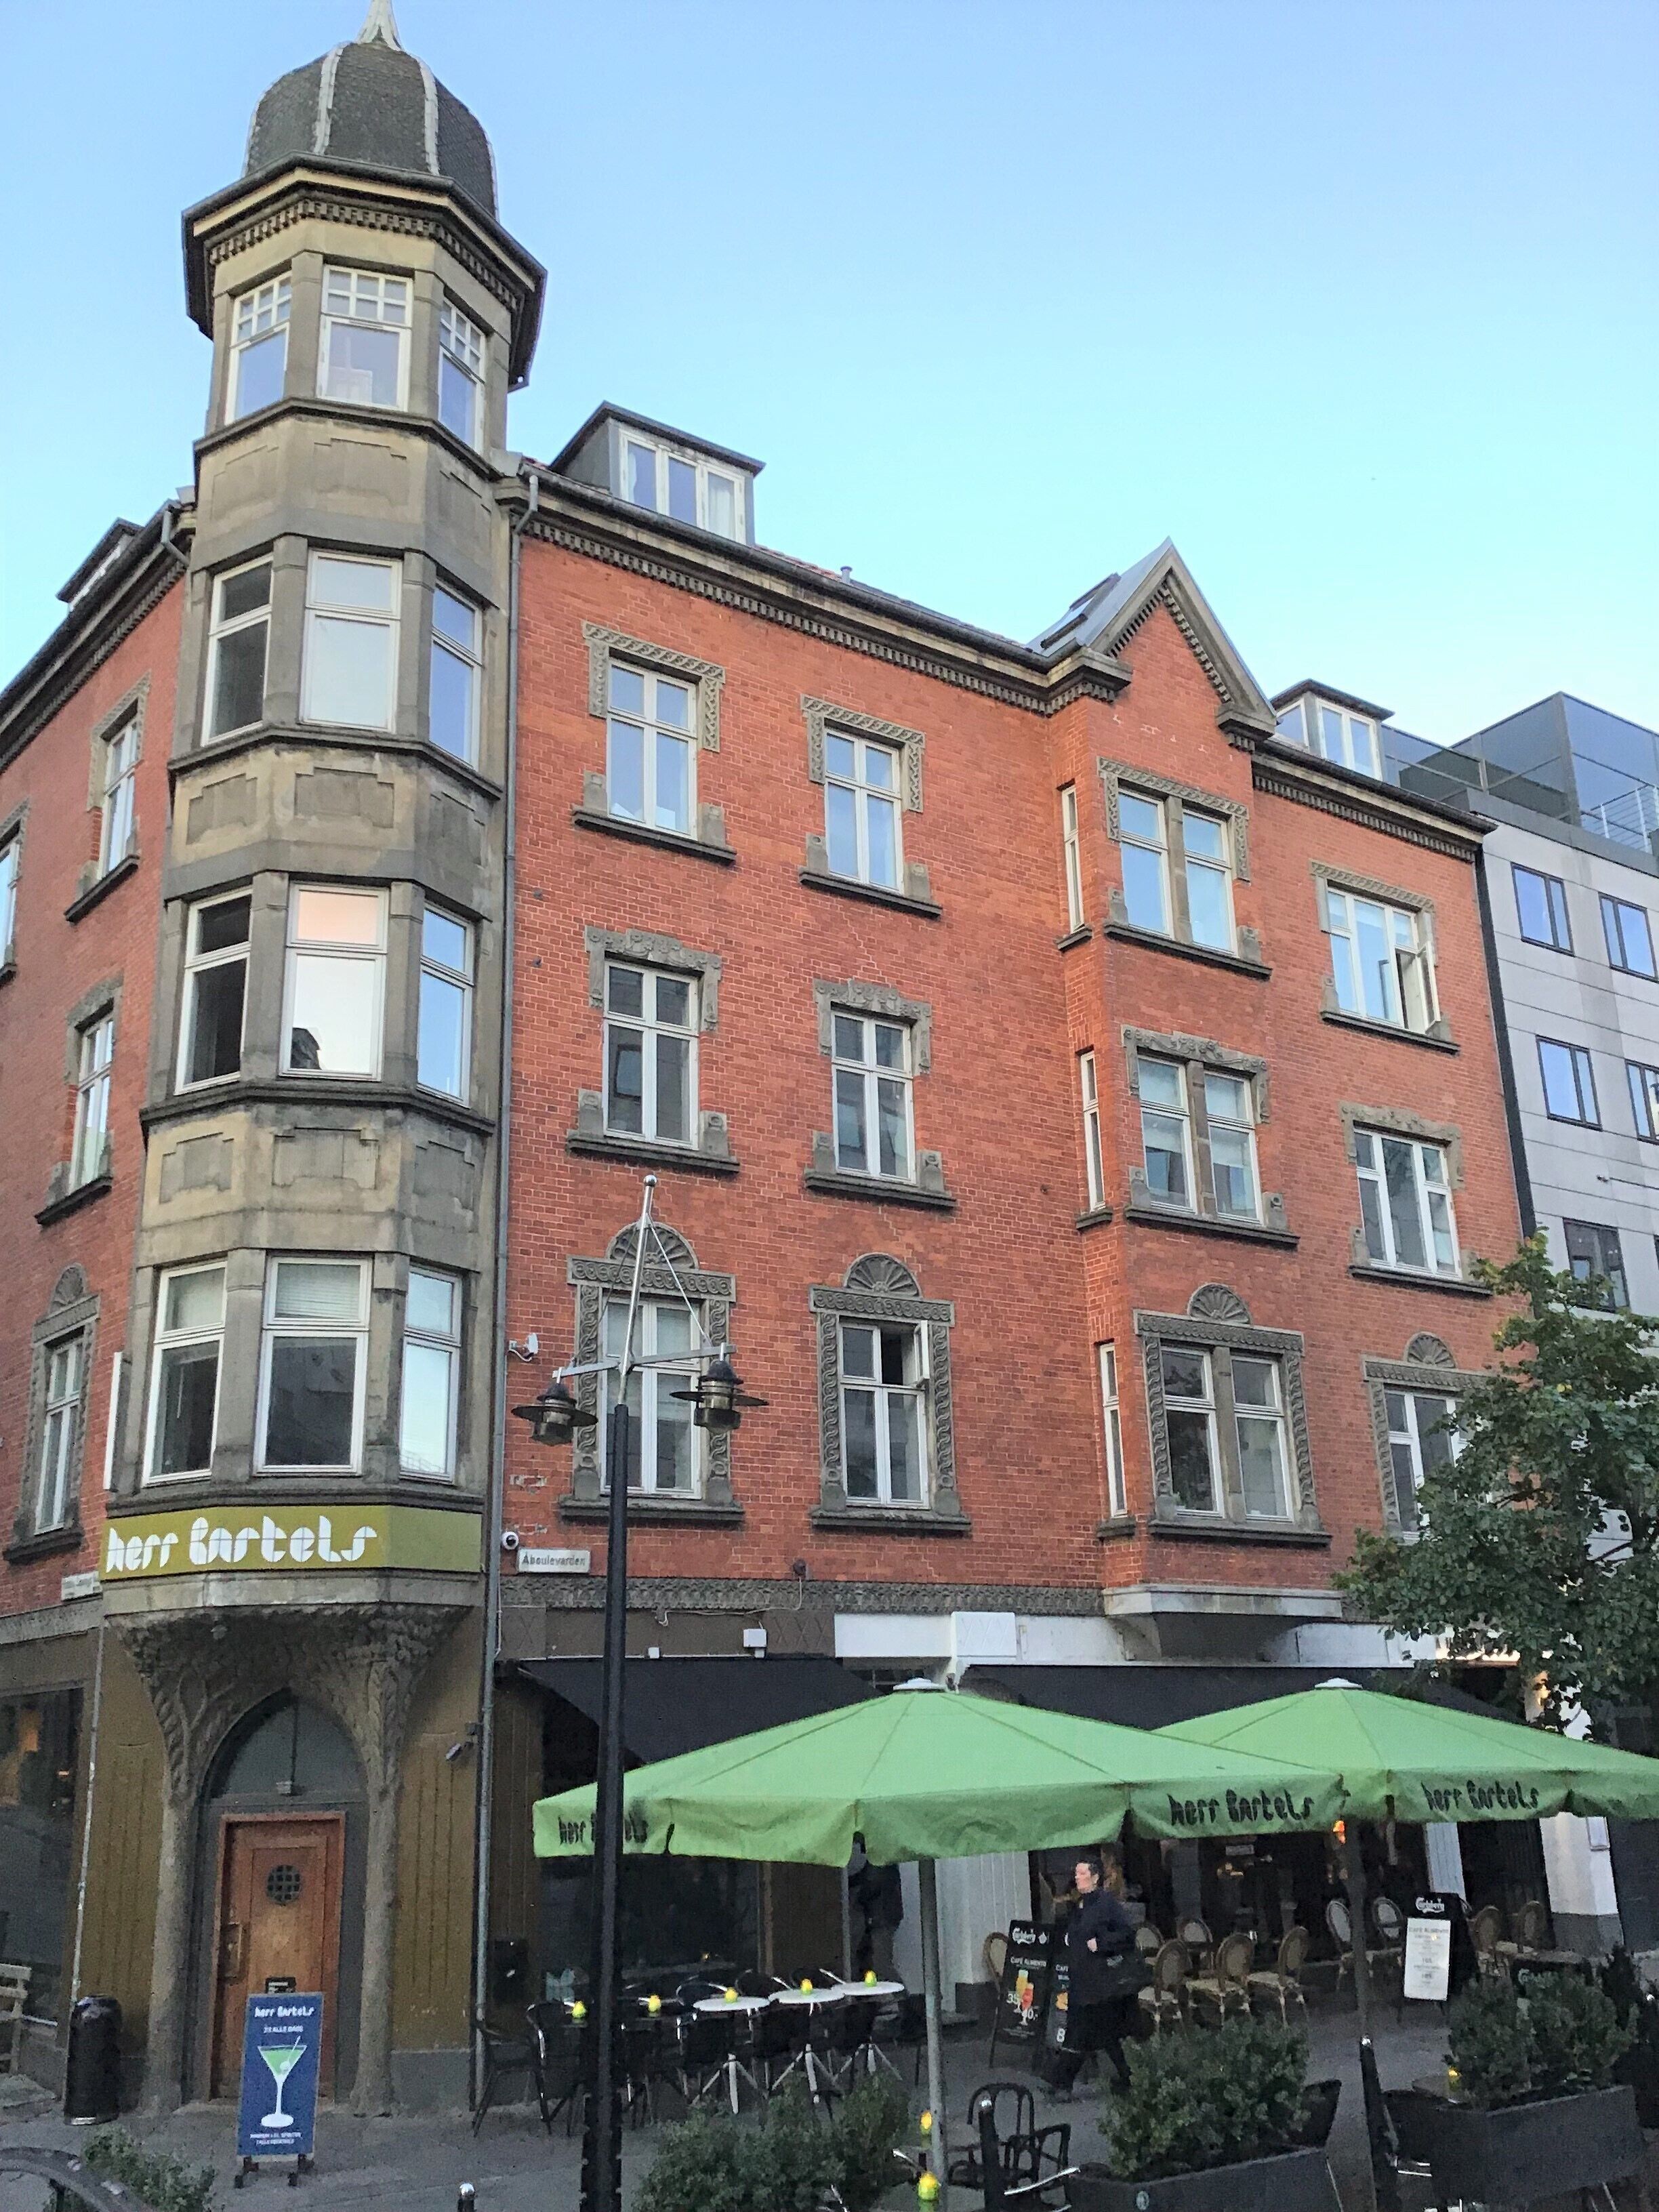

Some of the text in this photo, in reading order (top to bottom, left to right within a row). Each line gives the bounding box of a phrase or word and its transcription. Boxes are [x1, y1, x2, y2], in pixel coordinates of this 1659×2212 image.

[106, 1528, 179, 1573] herr
[1167, 1793, 1220, 1826] herr
[1421, 1782, 1462, 1811] herr
[558, 1815, 586, 1846] herr
